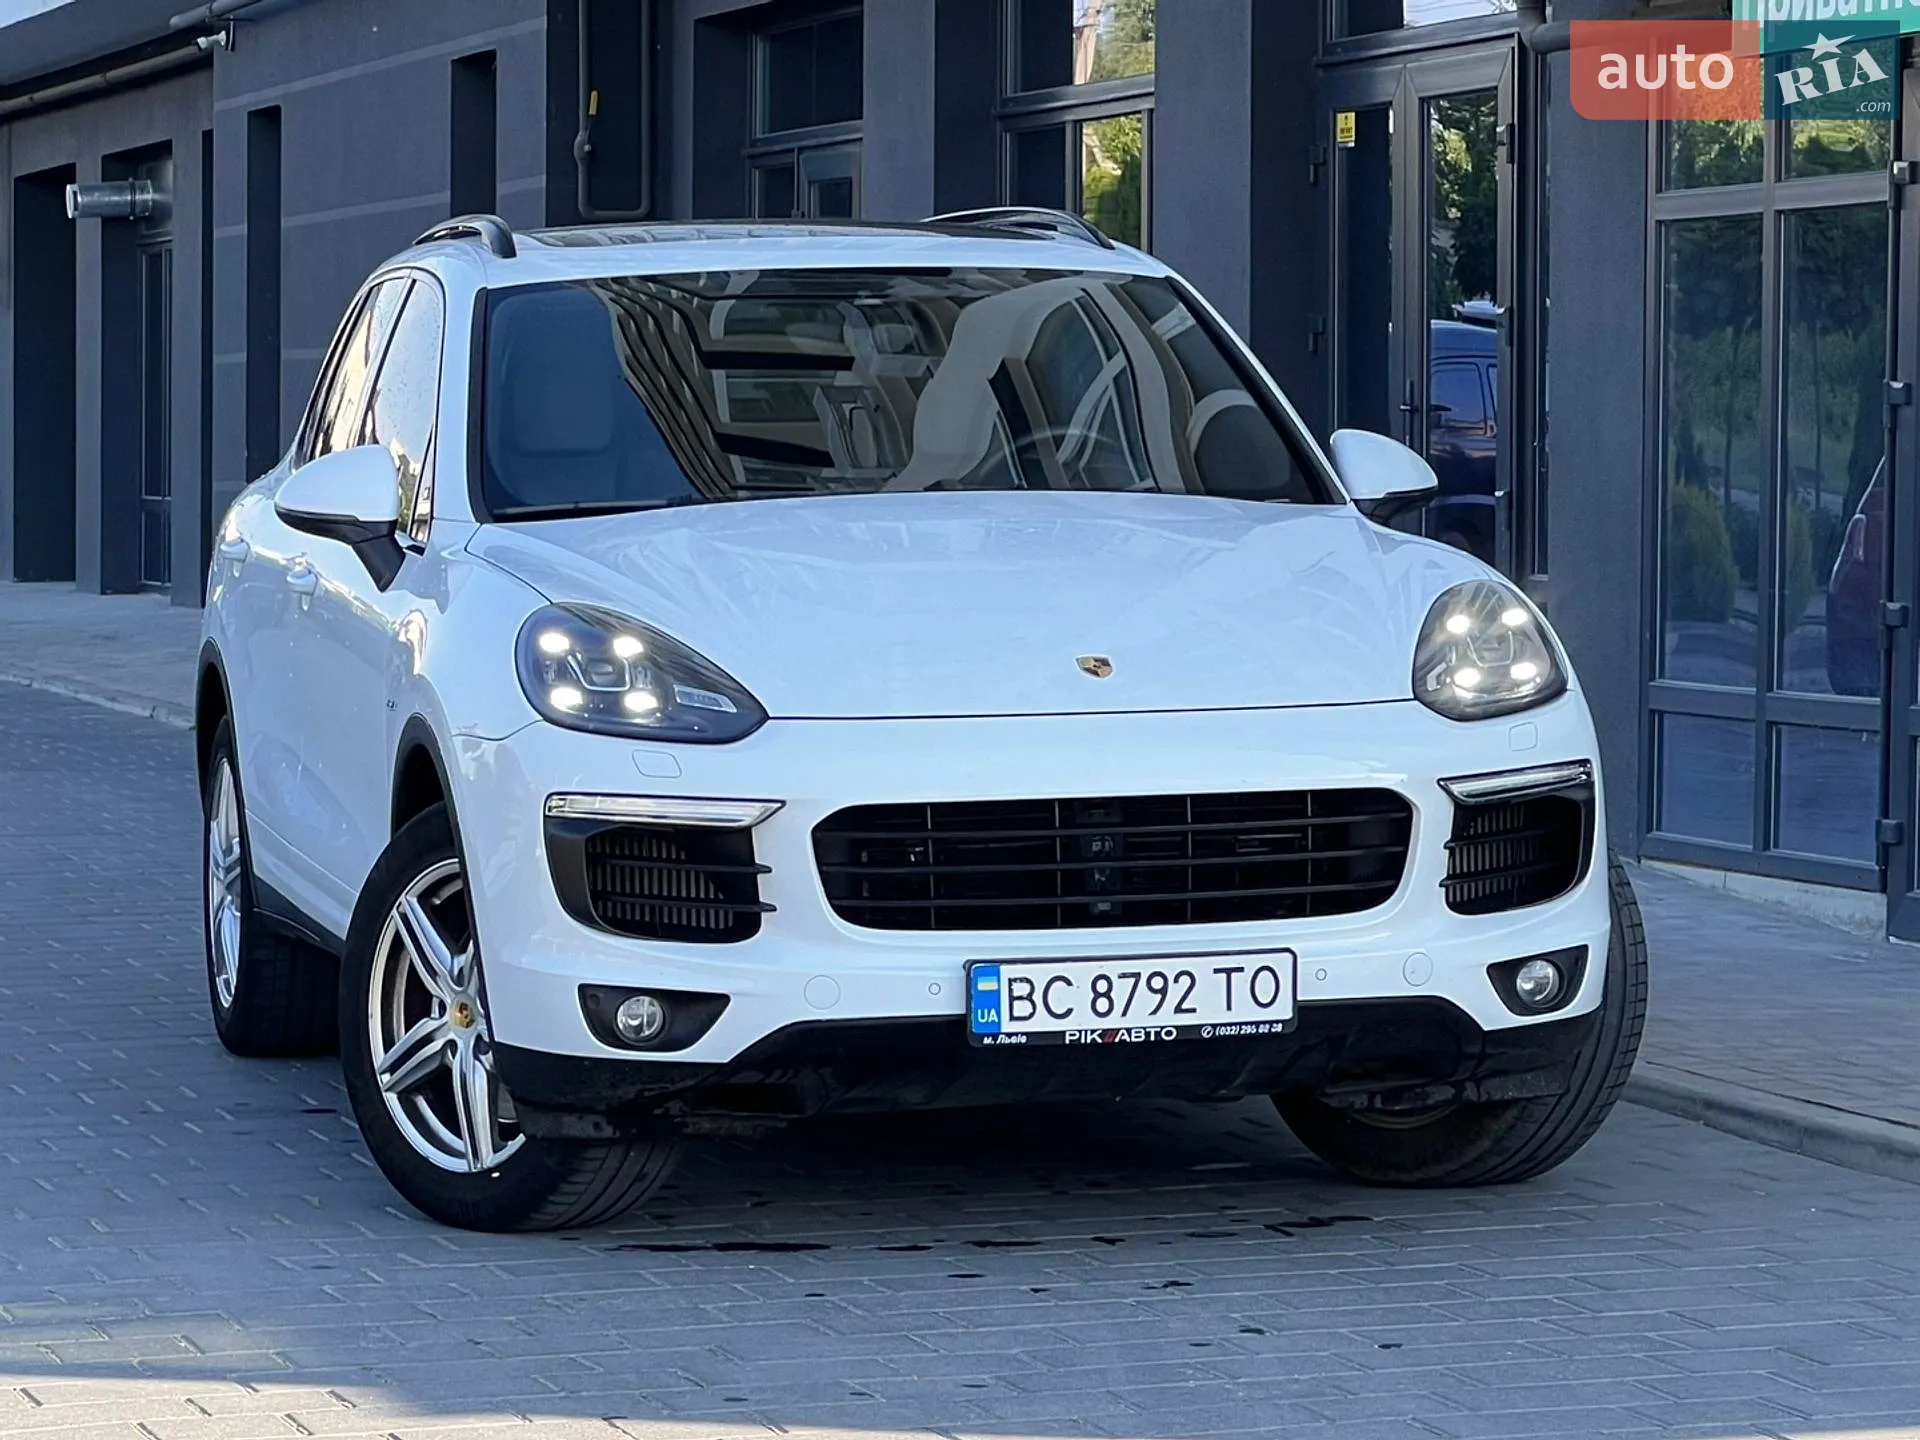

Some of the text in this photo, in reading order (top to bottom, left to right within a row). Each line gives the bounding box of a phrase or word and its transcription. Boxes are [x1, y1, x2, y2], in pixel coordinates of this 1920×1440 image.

[1008, 965, 1281, 1022] BC 8792 TO
[977, 1008, 999, 1023] UA
